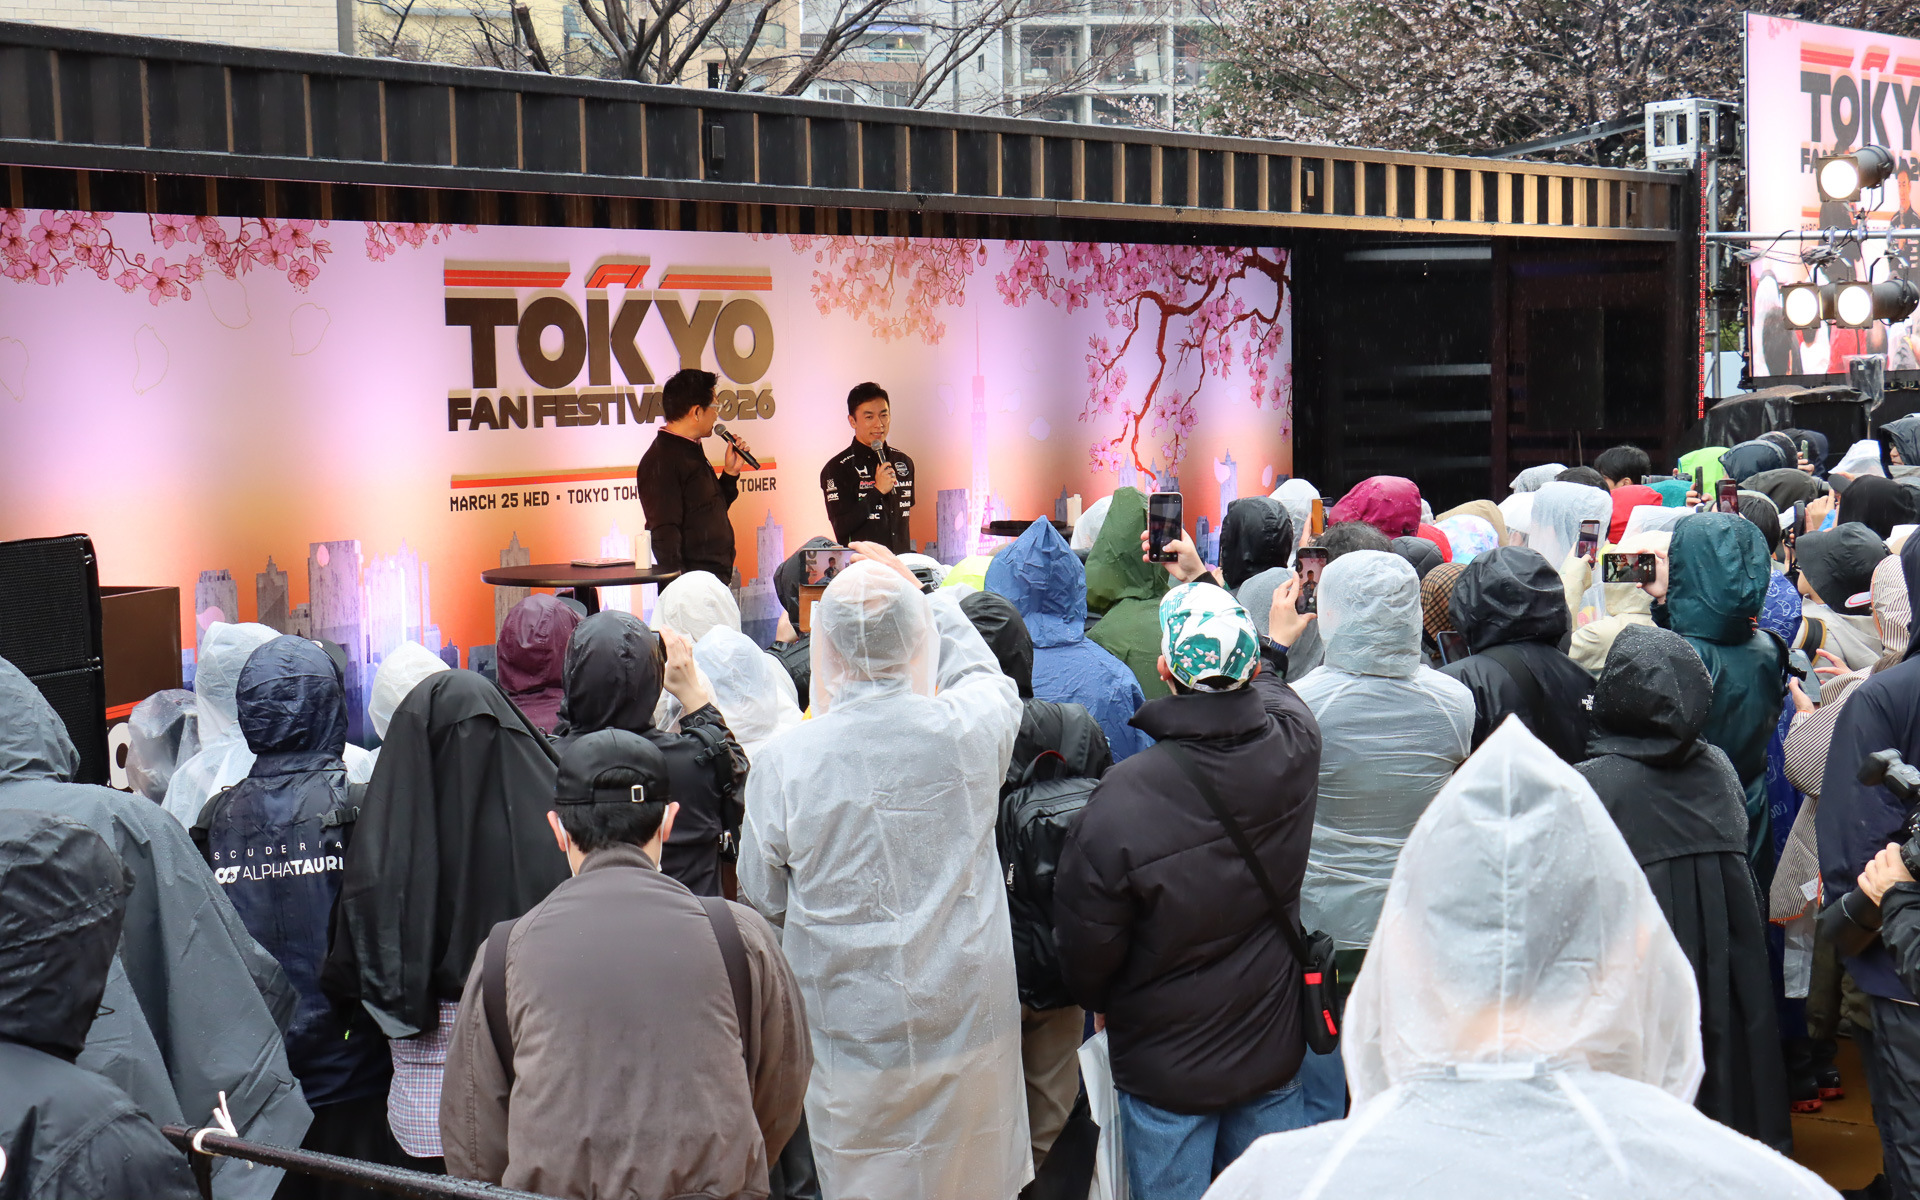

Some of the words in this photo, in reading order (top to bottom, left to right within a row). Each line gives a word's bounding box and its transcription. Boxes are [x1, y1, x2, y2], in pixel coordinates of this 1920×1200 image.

[1801, 71, 1920, 151] TOKY
[445, 297, 774, 389] TOKYO
[448, 396, 527, 431] FAN
[533, 392, 665, 428] FESTIVA
[716, 389, 775, 420] 026
[450, 494, 496, 512] MARCH
[501, 493, 519, 508] 25
[524, 491, 550, 507] WED
[568, 487, 609, 504] TOKYO
[614, 486, 640, 501] TOW
[740, 477, 777, 493] TOWER
[214, 841, 342, 860] SCUDERIA
[243, 855, 344, 881] ALPHATAURI
